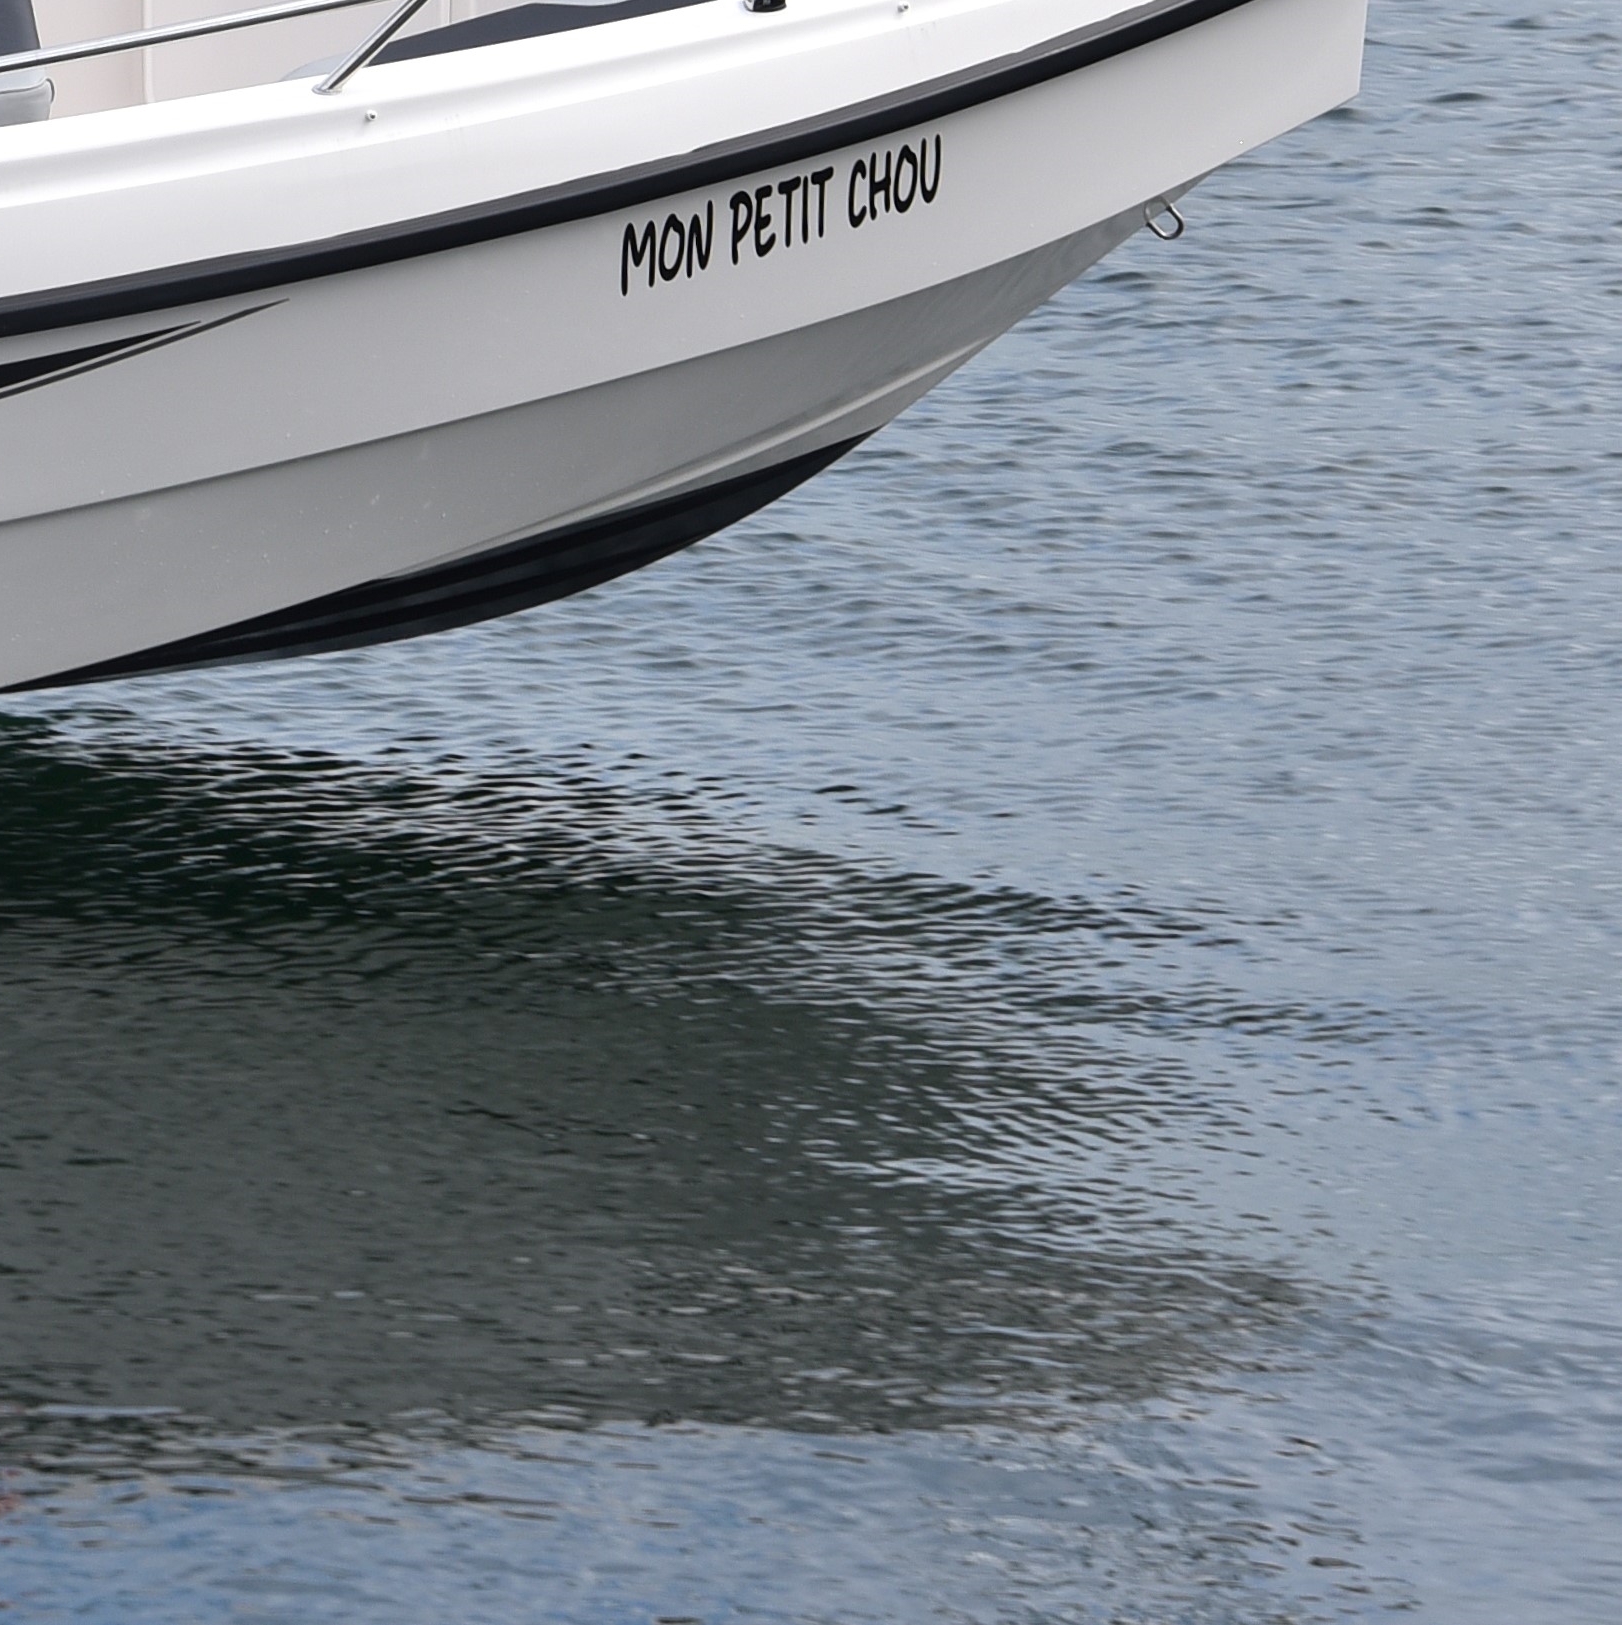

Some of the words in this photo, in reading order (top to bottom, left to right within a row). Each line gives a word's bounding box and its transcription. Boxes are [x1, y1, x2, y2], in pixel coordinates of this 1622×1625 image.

[620, 199, 714, 297] MON
[729, 166, 835, 265] PETIT
[848, 134, 943, 229] CHOU
